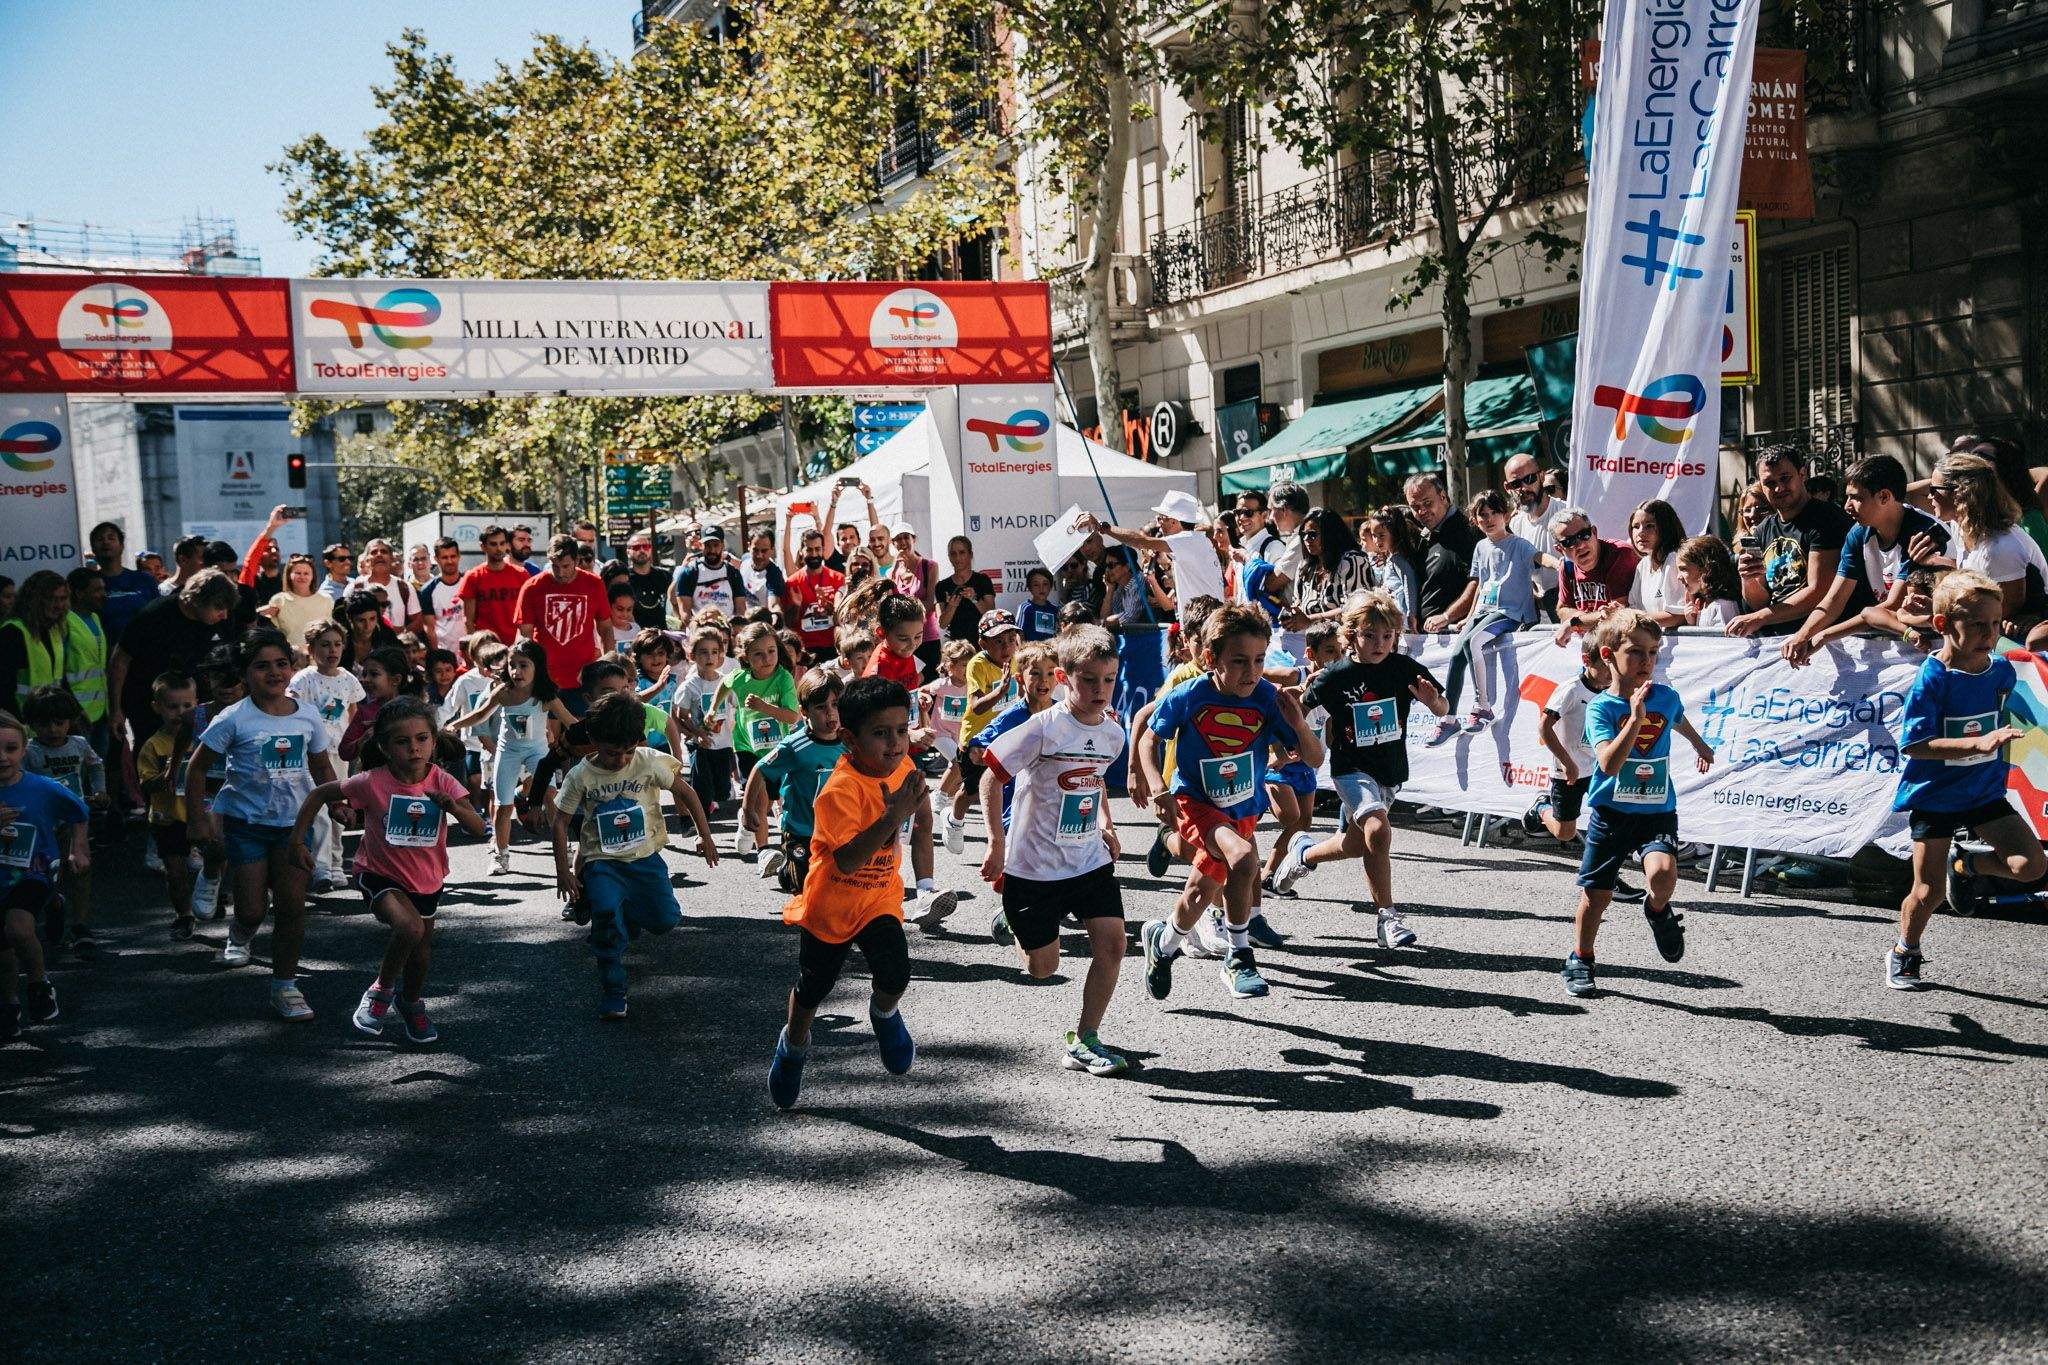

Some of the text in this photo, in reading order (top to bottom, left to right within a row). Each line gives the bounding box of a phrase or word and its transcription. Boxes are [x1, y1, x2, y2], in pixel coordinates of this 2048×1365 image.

[1744, 136, 1790, 148] ULTURAL
[1768, 150, 1799, 161] VILLA
[461, 319, 547, 339] MILLA
[84, 333, 152, 344] TotalEnergies
[890, 333, 942, 342] TotalEnergies
[543, 346, 690, 366] DE MADRID
[314, 362, 447, 382] TotalEnergies
[968, 461, 1052, 475] TotalEnergies
[1587, 455, 1706, 478] TotalEnergies
[991, 514, 1057, 529] MADRID
[0, 544, 76, 562] ADRID
[1713, 789, 1849, 815] totalenergies.es
